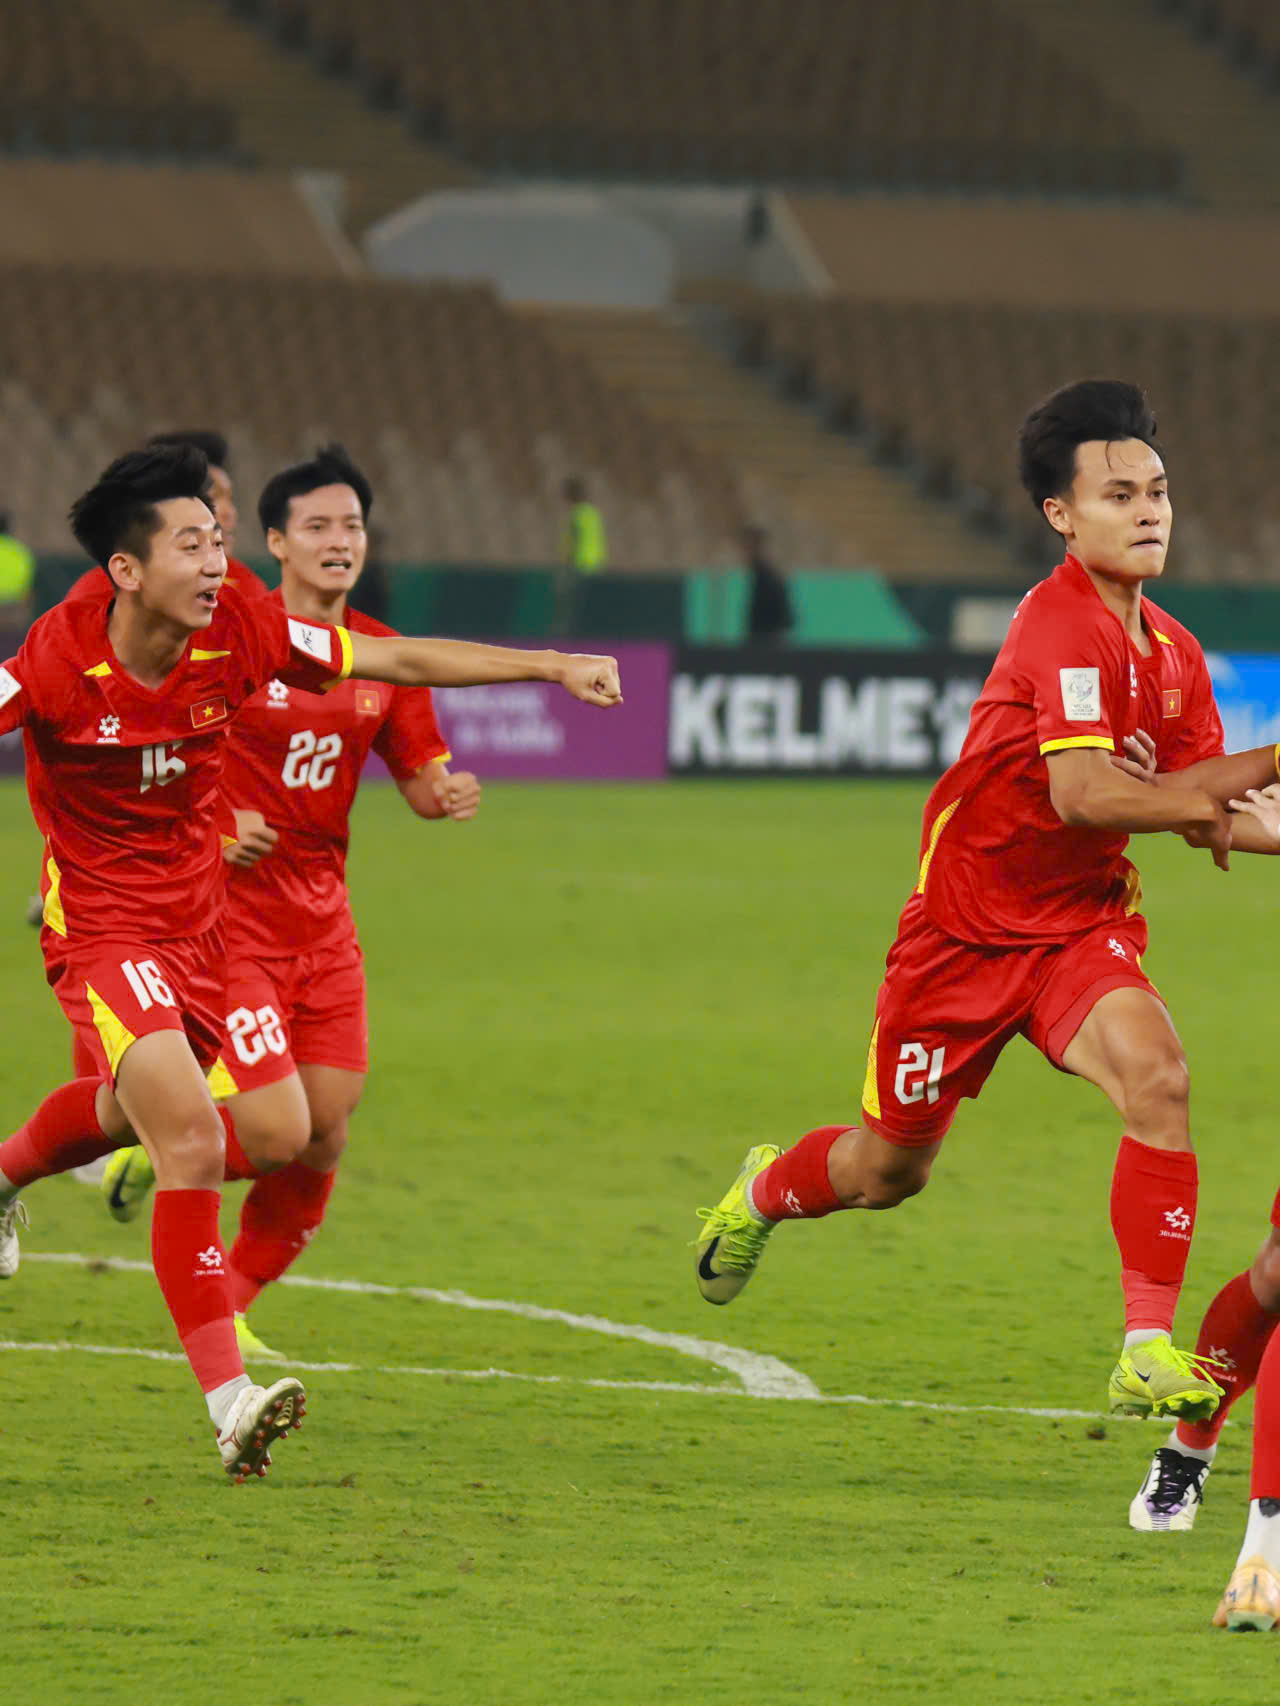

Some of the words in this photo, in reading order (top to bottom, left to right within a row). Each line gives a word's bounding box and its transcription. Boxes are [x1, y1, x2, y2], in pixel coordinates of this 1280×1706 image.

[668, 673, 933, 769] KELME
[140, 739, 187, 794] 16
[281, 729, 343, 791] 22
[120, 959, 177, 1012] 16
[225, 1005, 288, 1066] 22
[894, 1042, 946, 1105] 21
